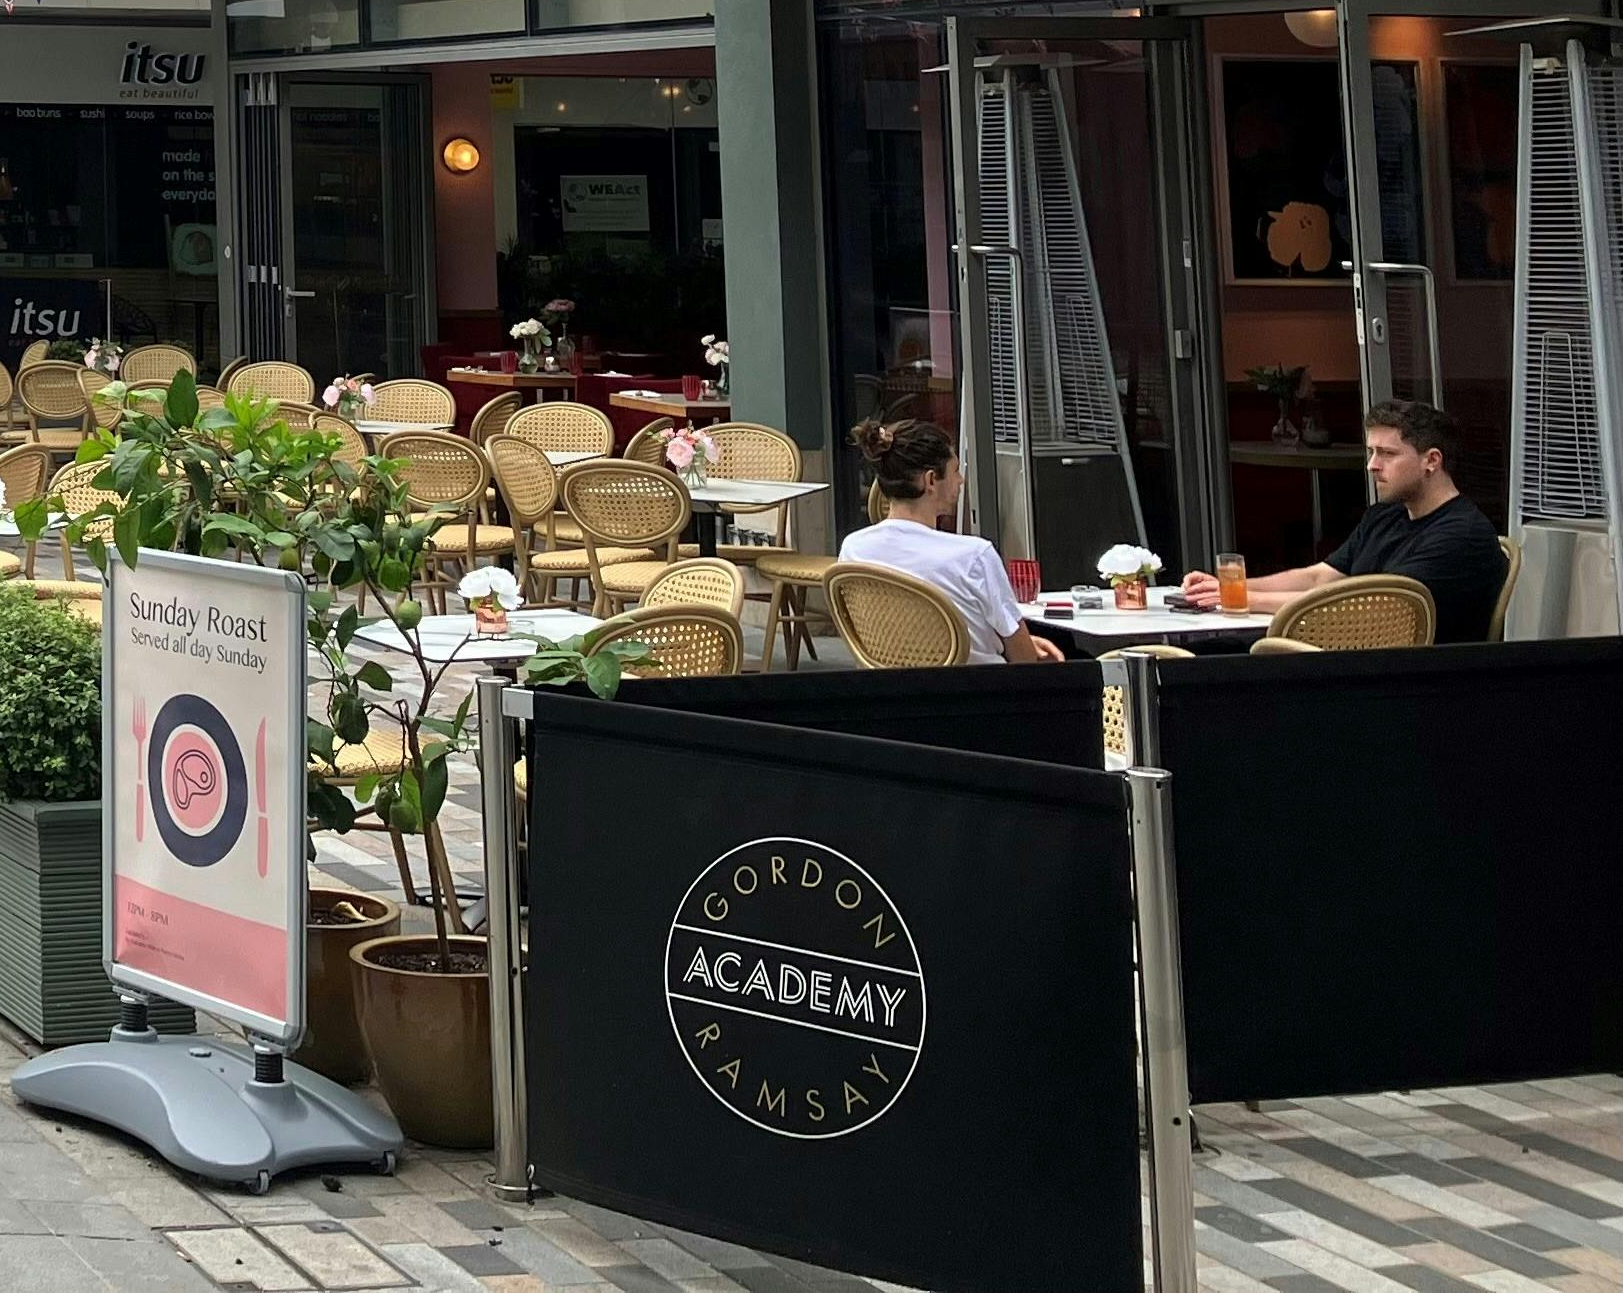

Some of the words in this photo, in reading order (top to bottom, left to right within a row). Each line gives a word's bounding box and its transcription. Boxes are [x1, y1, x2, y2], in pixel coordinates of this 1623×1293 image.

[119, 41, 206, 85] itsu
[16, 107, 35, 118] bao
[36, 108, 61, 118] buns
[80, 109, 105, 119] sushi
[125, 109, 155, 120] soups
[174, 109, 192, 120] rice
[119, 89, 137, 99] eat
[143, 88, 199, 99] beautiful
[162, 148, 200, 163] made
[162, 171, 180, 181] on
[183, 168, 204, 181] the
[10, 298, 80, 336] itsu
[130, 592, 200, 637] Sunday
[207, 606, 268, 642] Roast
[131, 627, 169, 651] Served
[172, 636, 187, 654] all
[190, 638, 213, 664] day
[217, 644, 268, 674] Sunday
[128, 901, 145, 917] 12PM
[151, 910, 169, 926] 8PM
[703, 856, 896, 949] GORDON
[682, 946, 906, 1027] ACADEMY
[695, 1022, 890, 1121] RAMSAY
